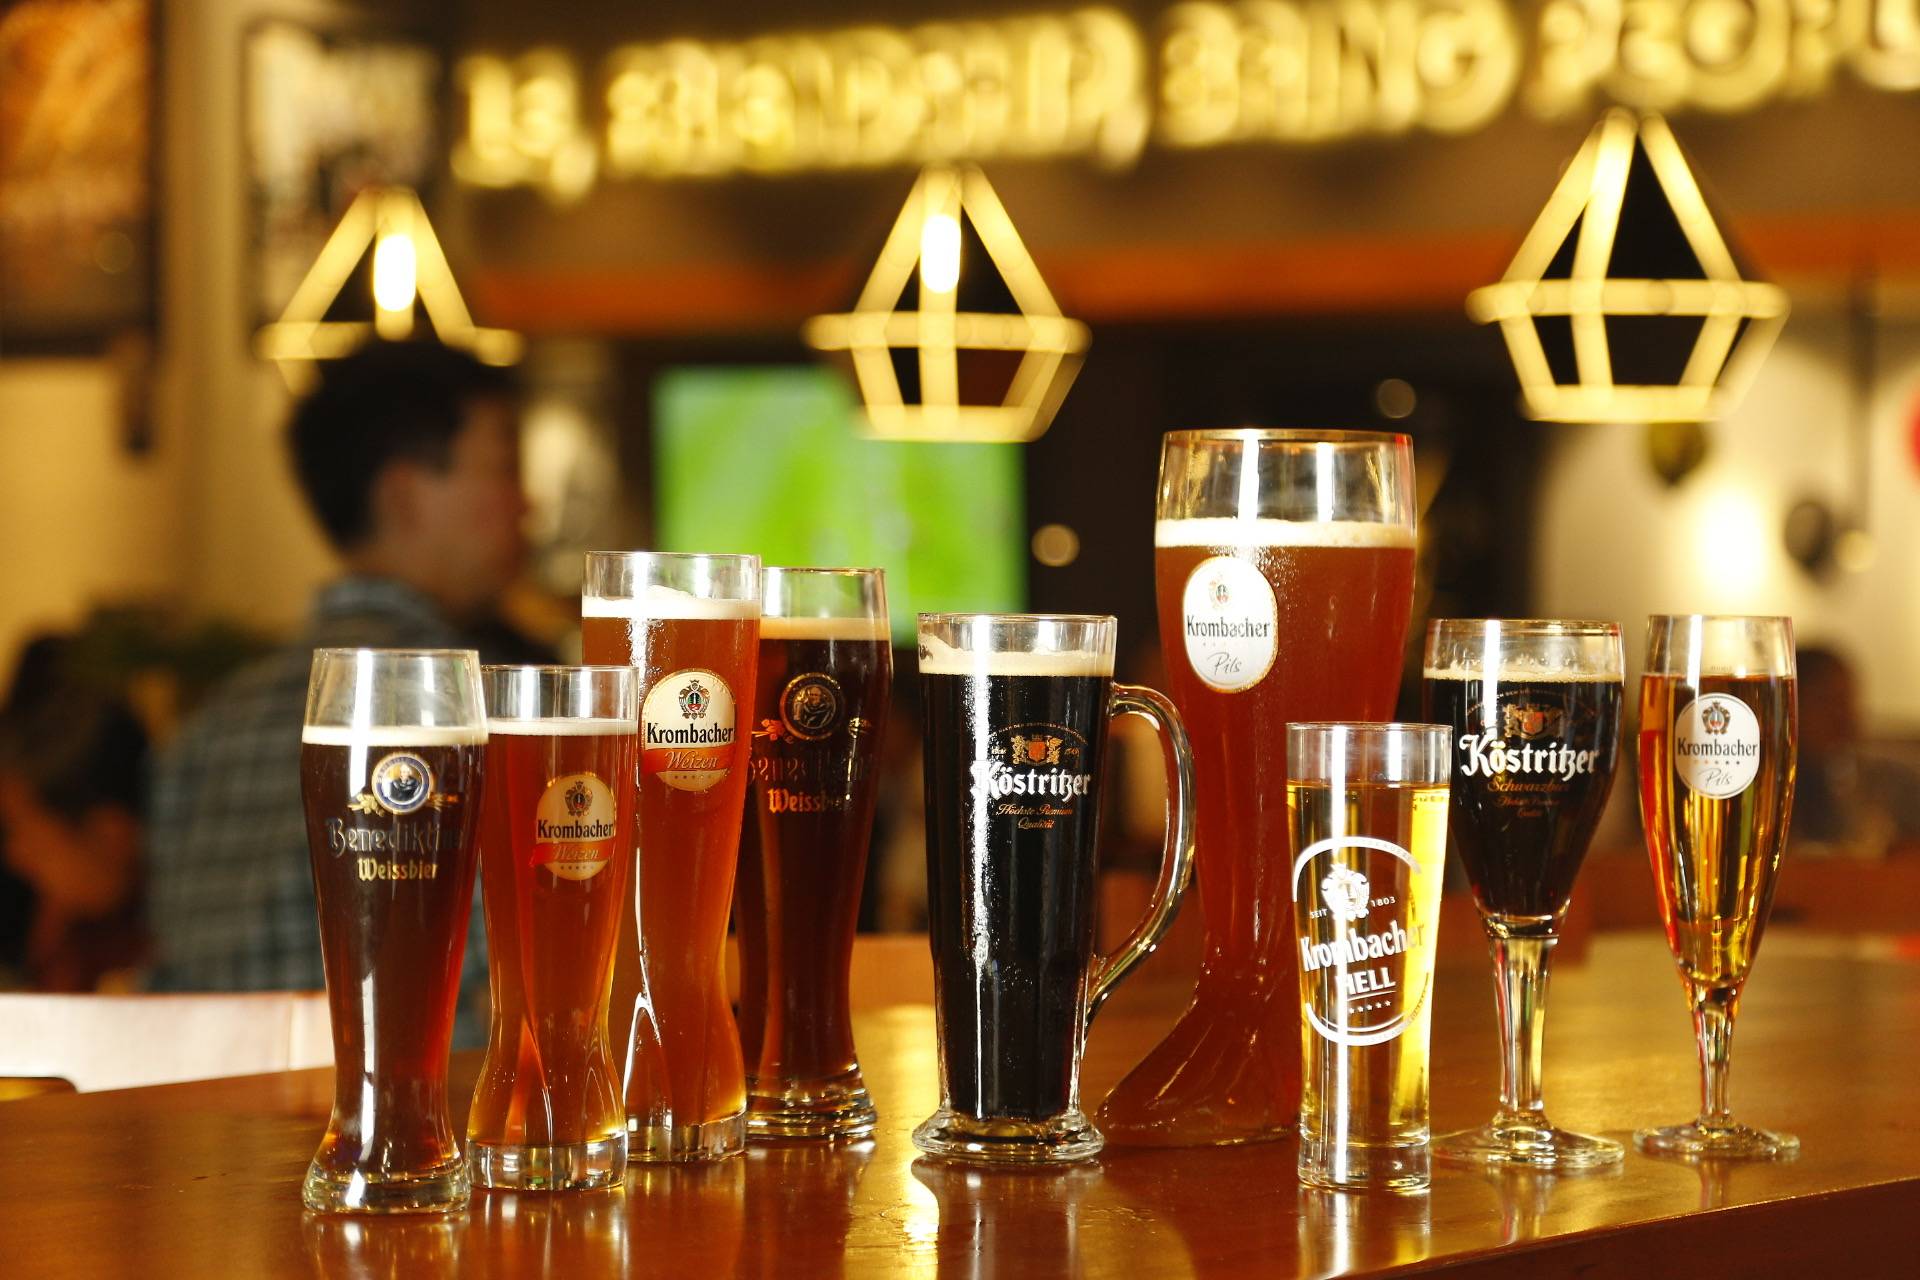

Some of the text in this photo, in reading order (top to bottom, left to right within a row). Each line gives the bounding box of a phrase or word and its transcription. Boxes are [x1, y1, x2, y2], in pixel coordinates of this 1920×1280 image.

[1186, 614, 1270, 638] Krombacher
[1207, 651, 1242, 675] Pils
[647, 722, 733, 744] Krombacher
[1459, 734, 1601, 782] Köstritzer
[1677, 737, 1758, 757] Krombacher
[665, 751, 718, 769] Weizen
[969, 760, 1091, 802] Köstritzer
[1698, 767, 1732, 787] Pils
[537, 819, 614, 838] Krombacher
[357, 857, 439, 882] Weissbier
[1370, 896, 1396, 908] 1803
